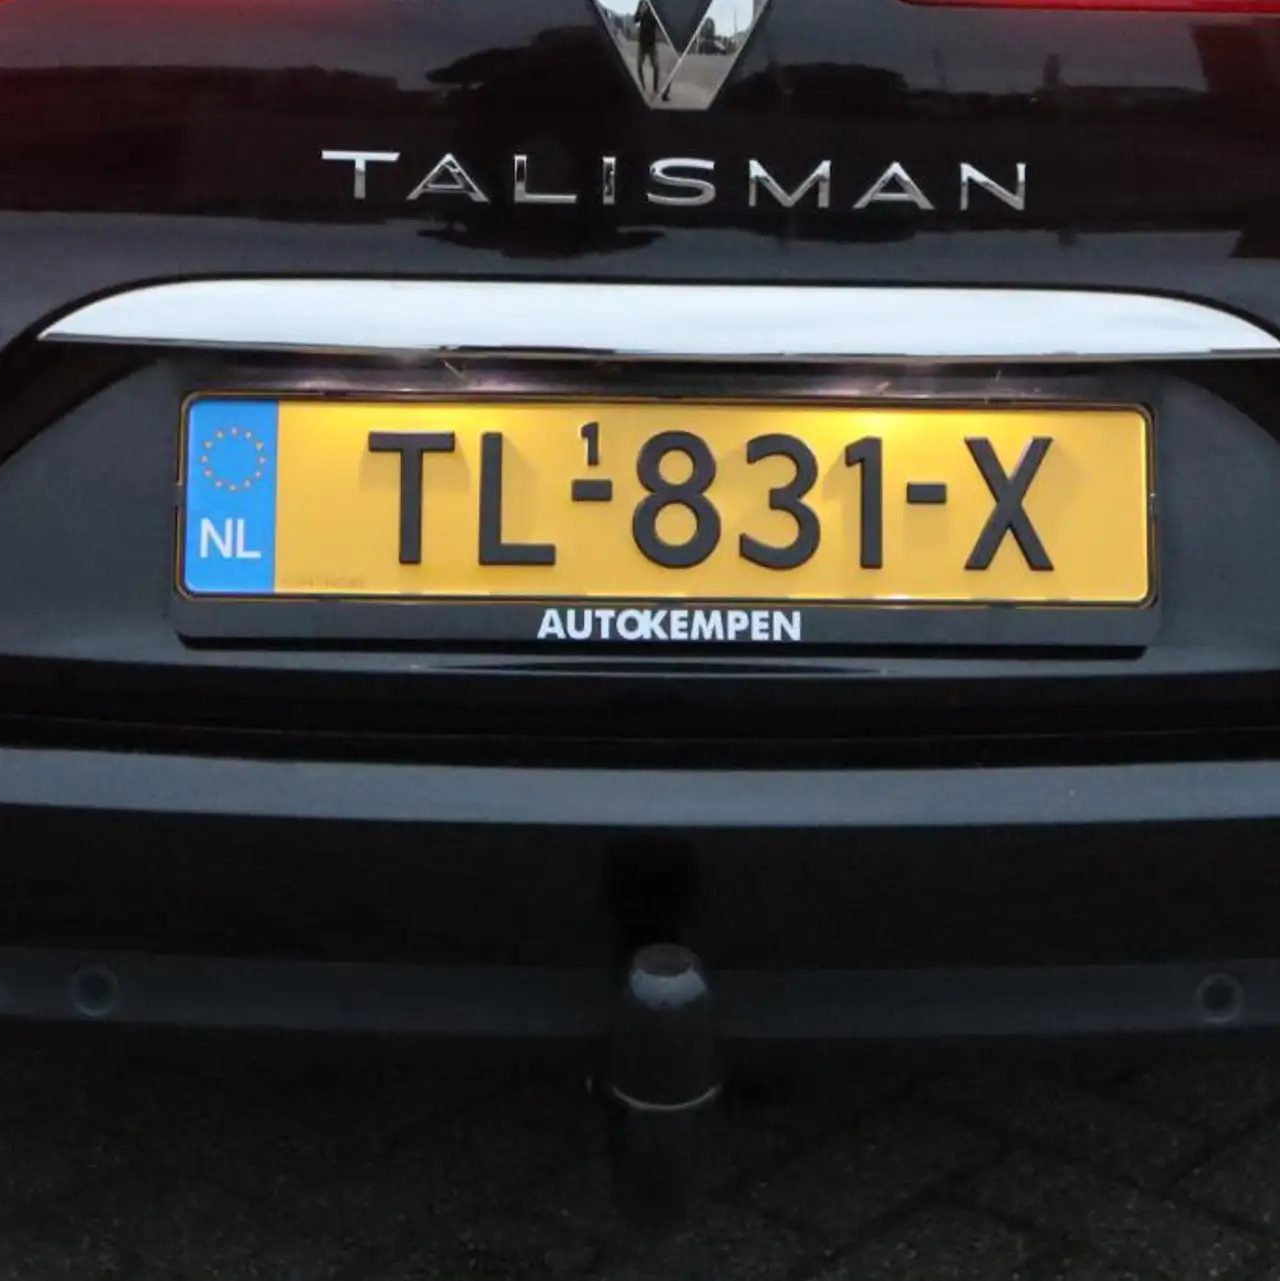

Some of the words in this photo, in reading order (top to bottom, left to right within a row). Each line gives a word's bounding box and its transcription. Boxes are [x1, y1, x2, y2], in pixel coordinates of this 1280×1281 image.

[321, 149, 1027, 211] TALISMAN
[199, 517, 263, 560] NL
[536, 607, 802, 642] AUTOKEMPEN
